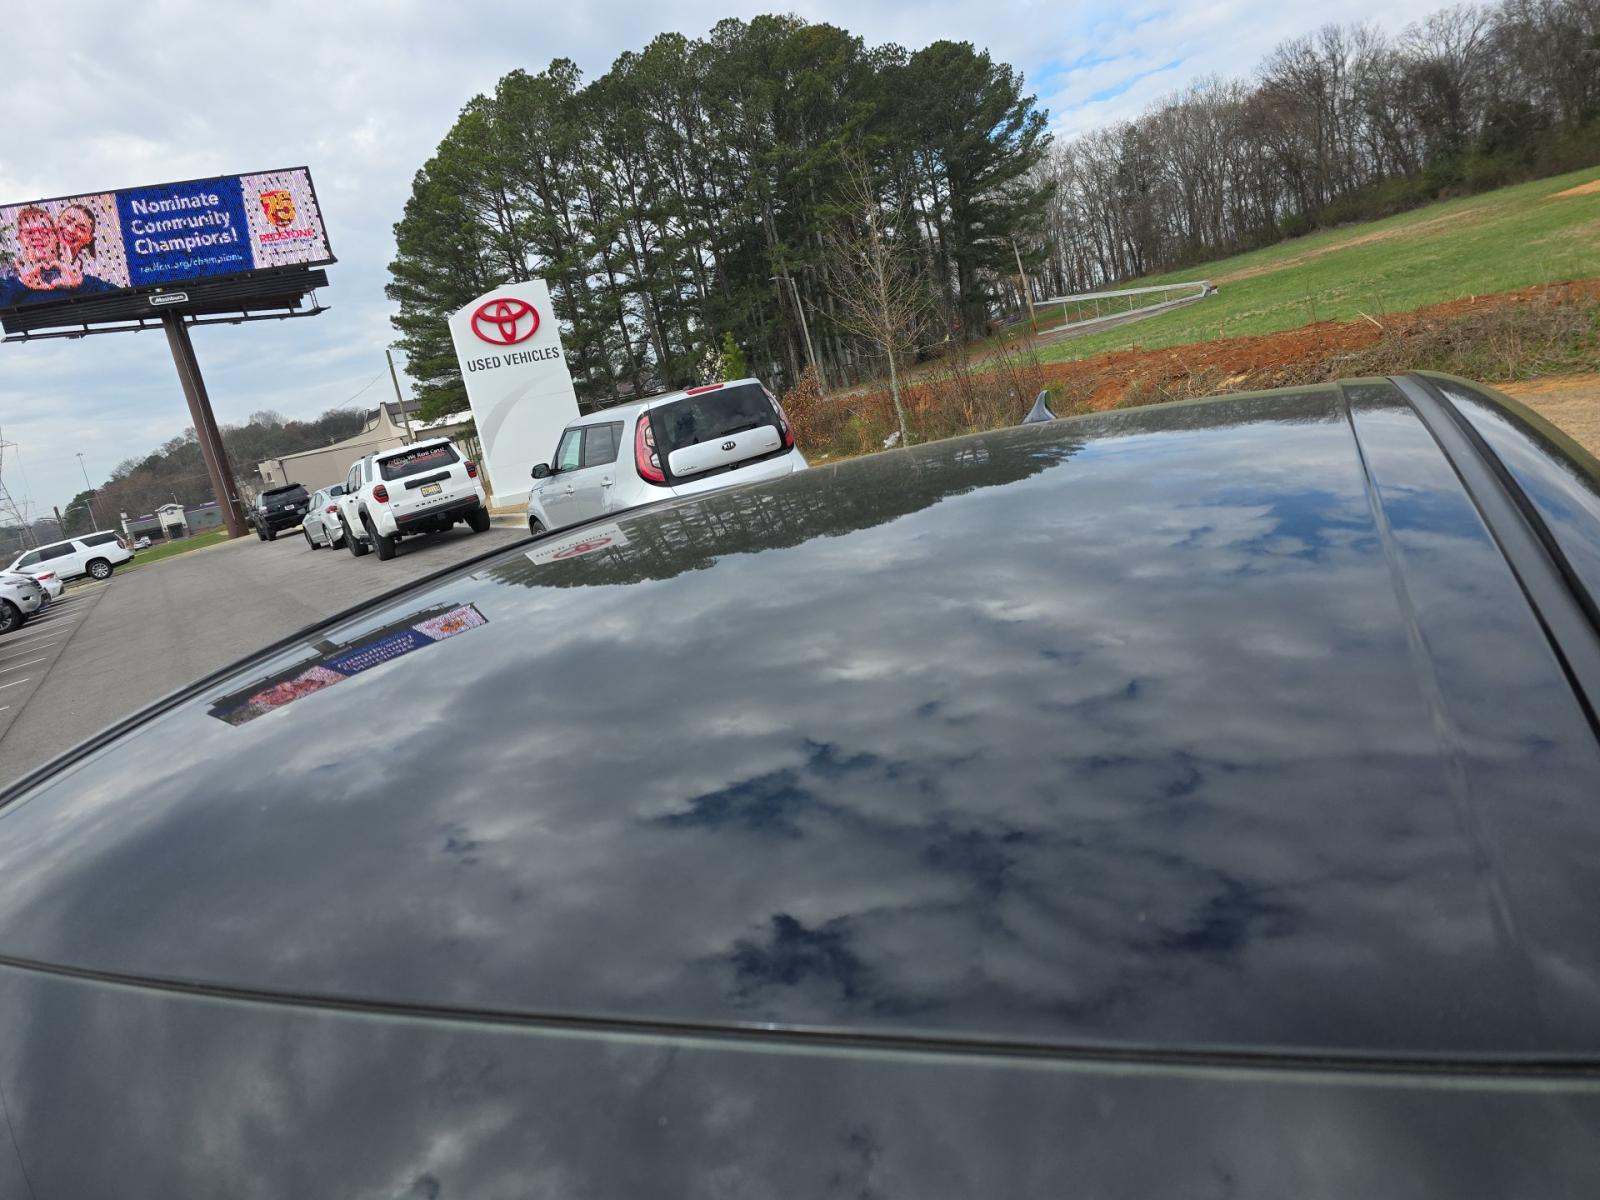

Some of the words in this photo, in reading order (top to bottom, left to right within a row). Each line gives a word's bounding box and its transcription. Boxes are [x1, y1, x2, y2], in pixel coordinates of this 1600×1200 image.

[131, 193, 220, 216] Nominate
[131, 210, 230, 235] Community
[134, 227, 239, 255] Champions!
[467, 356, 501, 372] USED
[504, 346, 560, 366] VEHICLES
